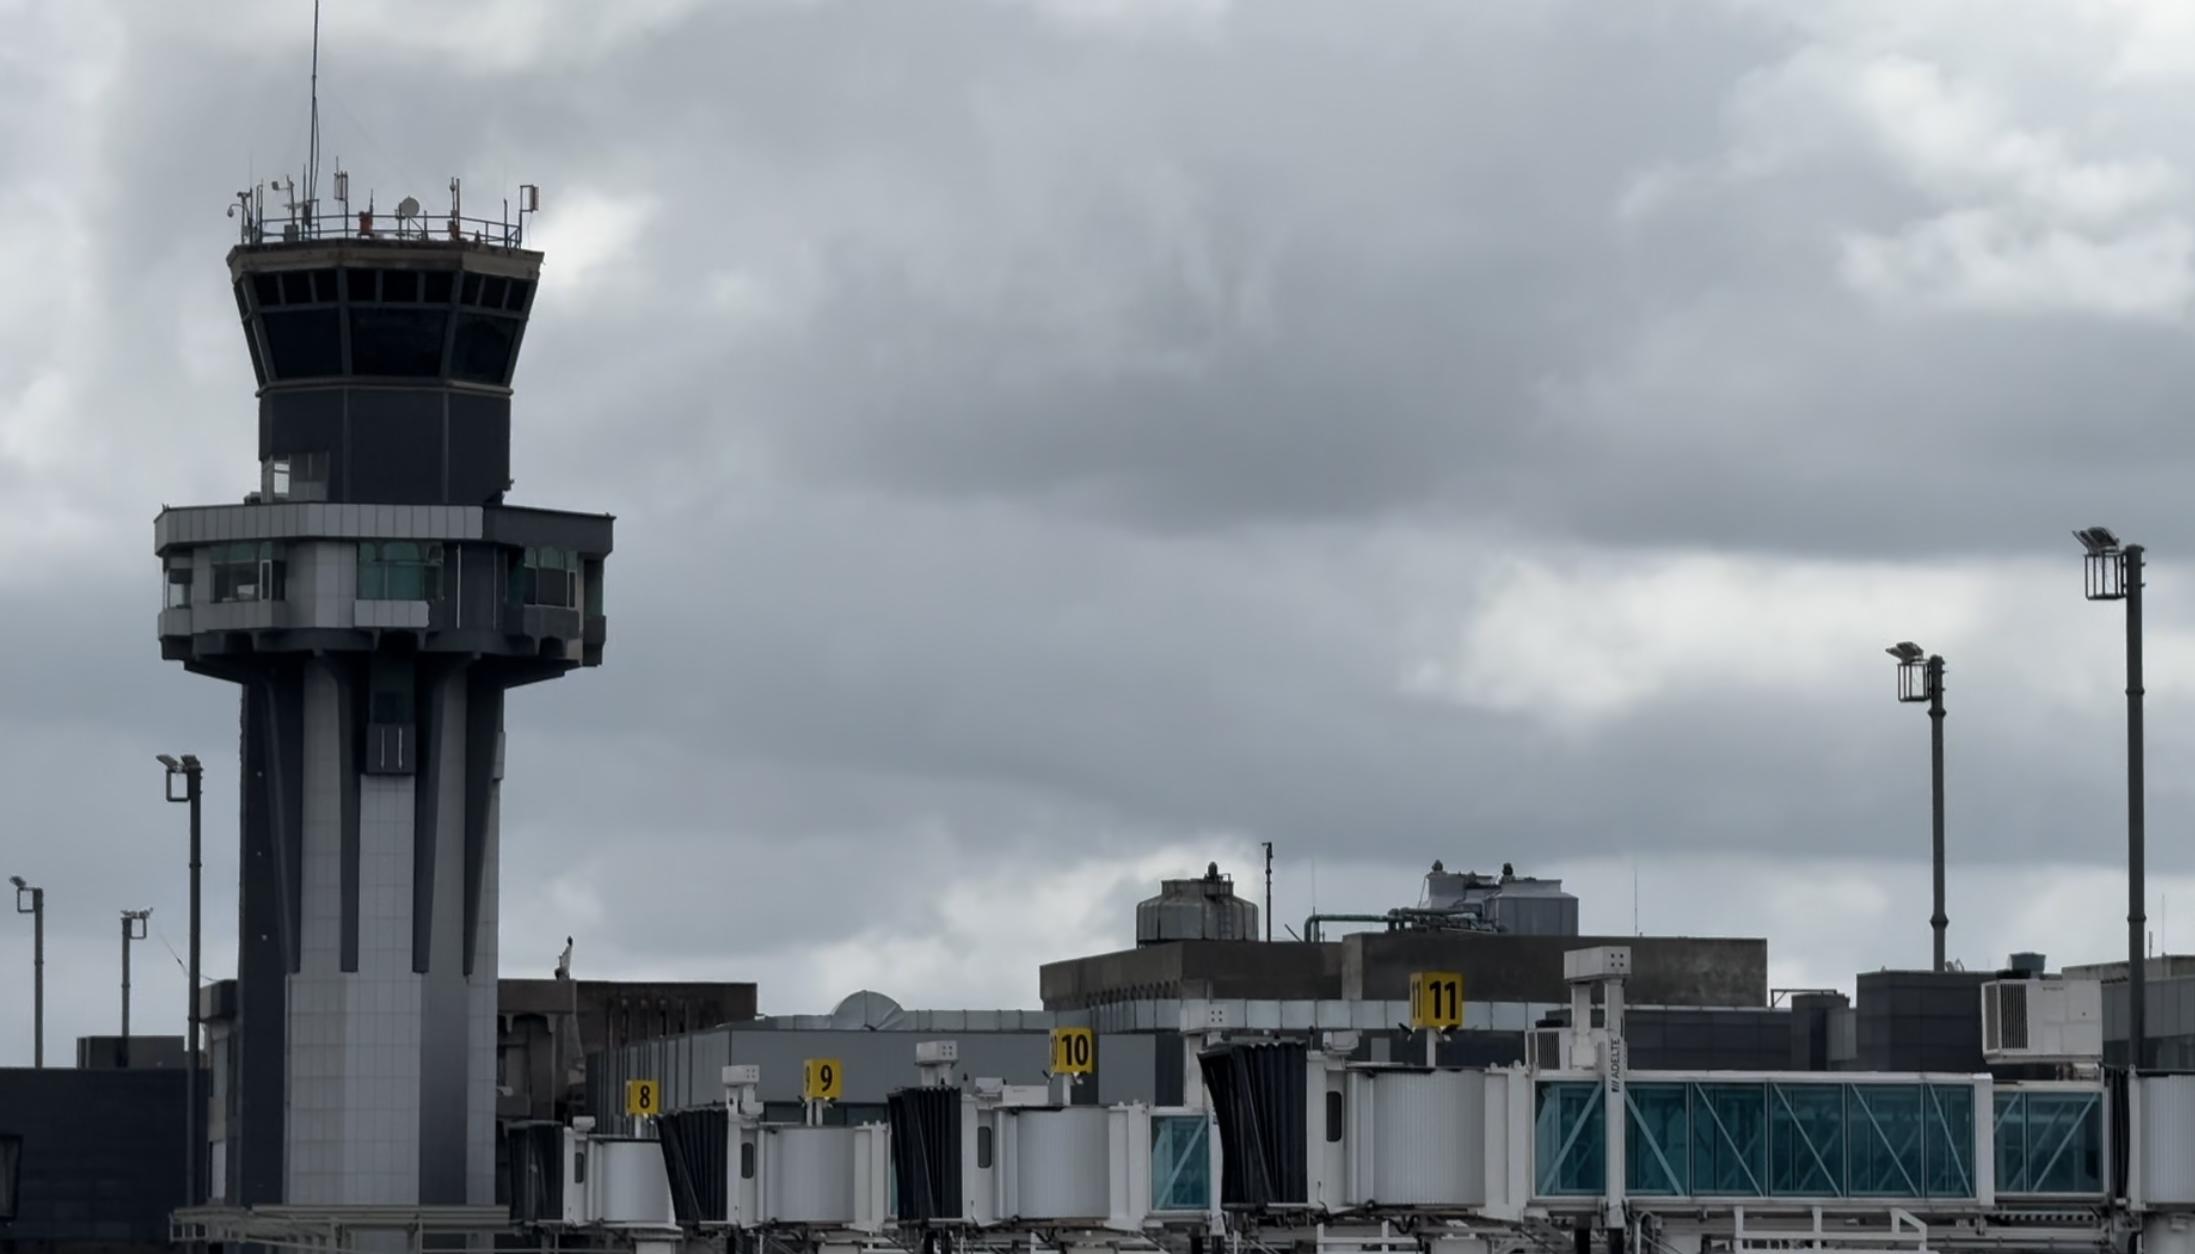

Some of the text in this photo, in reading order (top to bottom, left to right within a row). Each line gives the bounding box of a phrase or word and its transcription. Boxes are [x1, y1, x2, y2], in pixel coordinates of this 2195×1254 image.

[1429, 981, 1456, 1019] 11
[1062, 1034, 1088, 1066] 10
[1610, 1038, 1620, 1079] ADELTE
[821, 1065, 832, 1092] 9
[640, 1085, 650, 1109] 8
